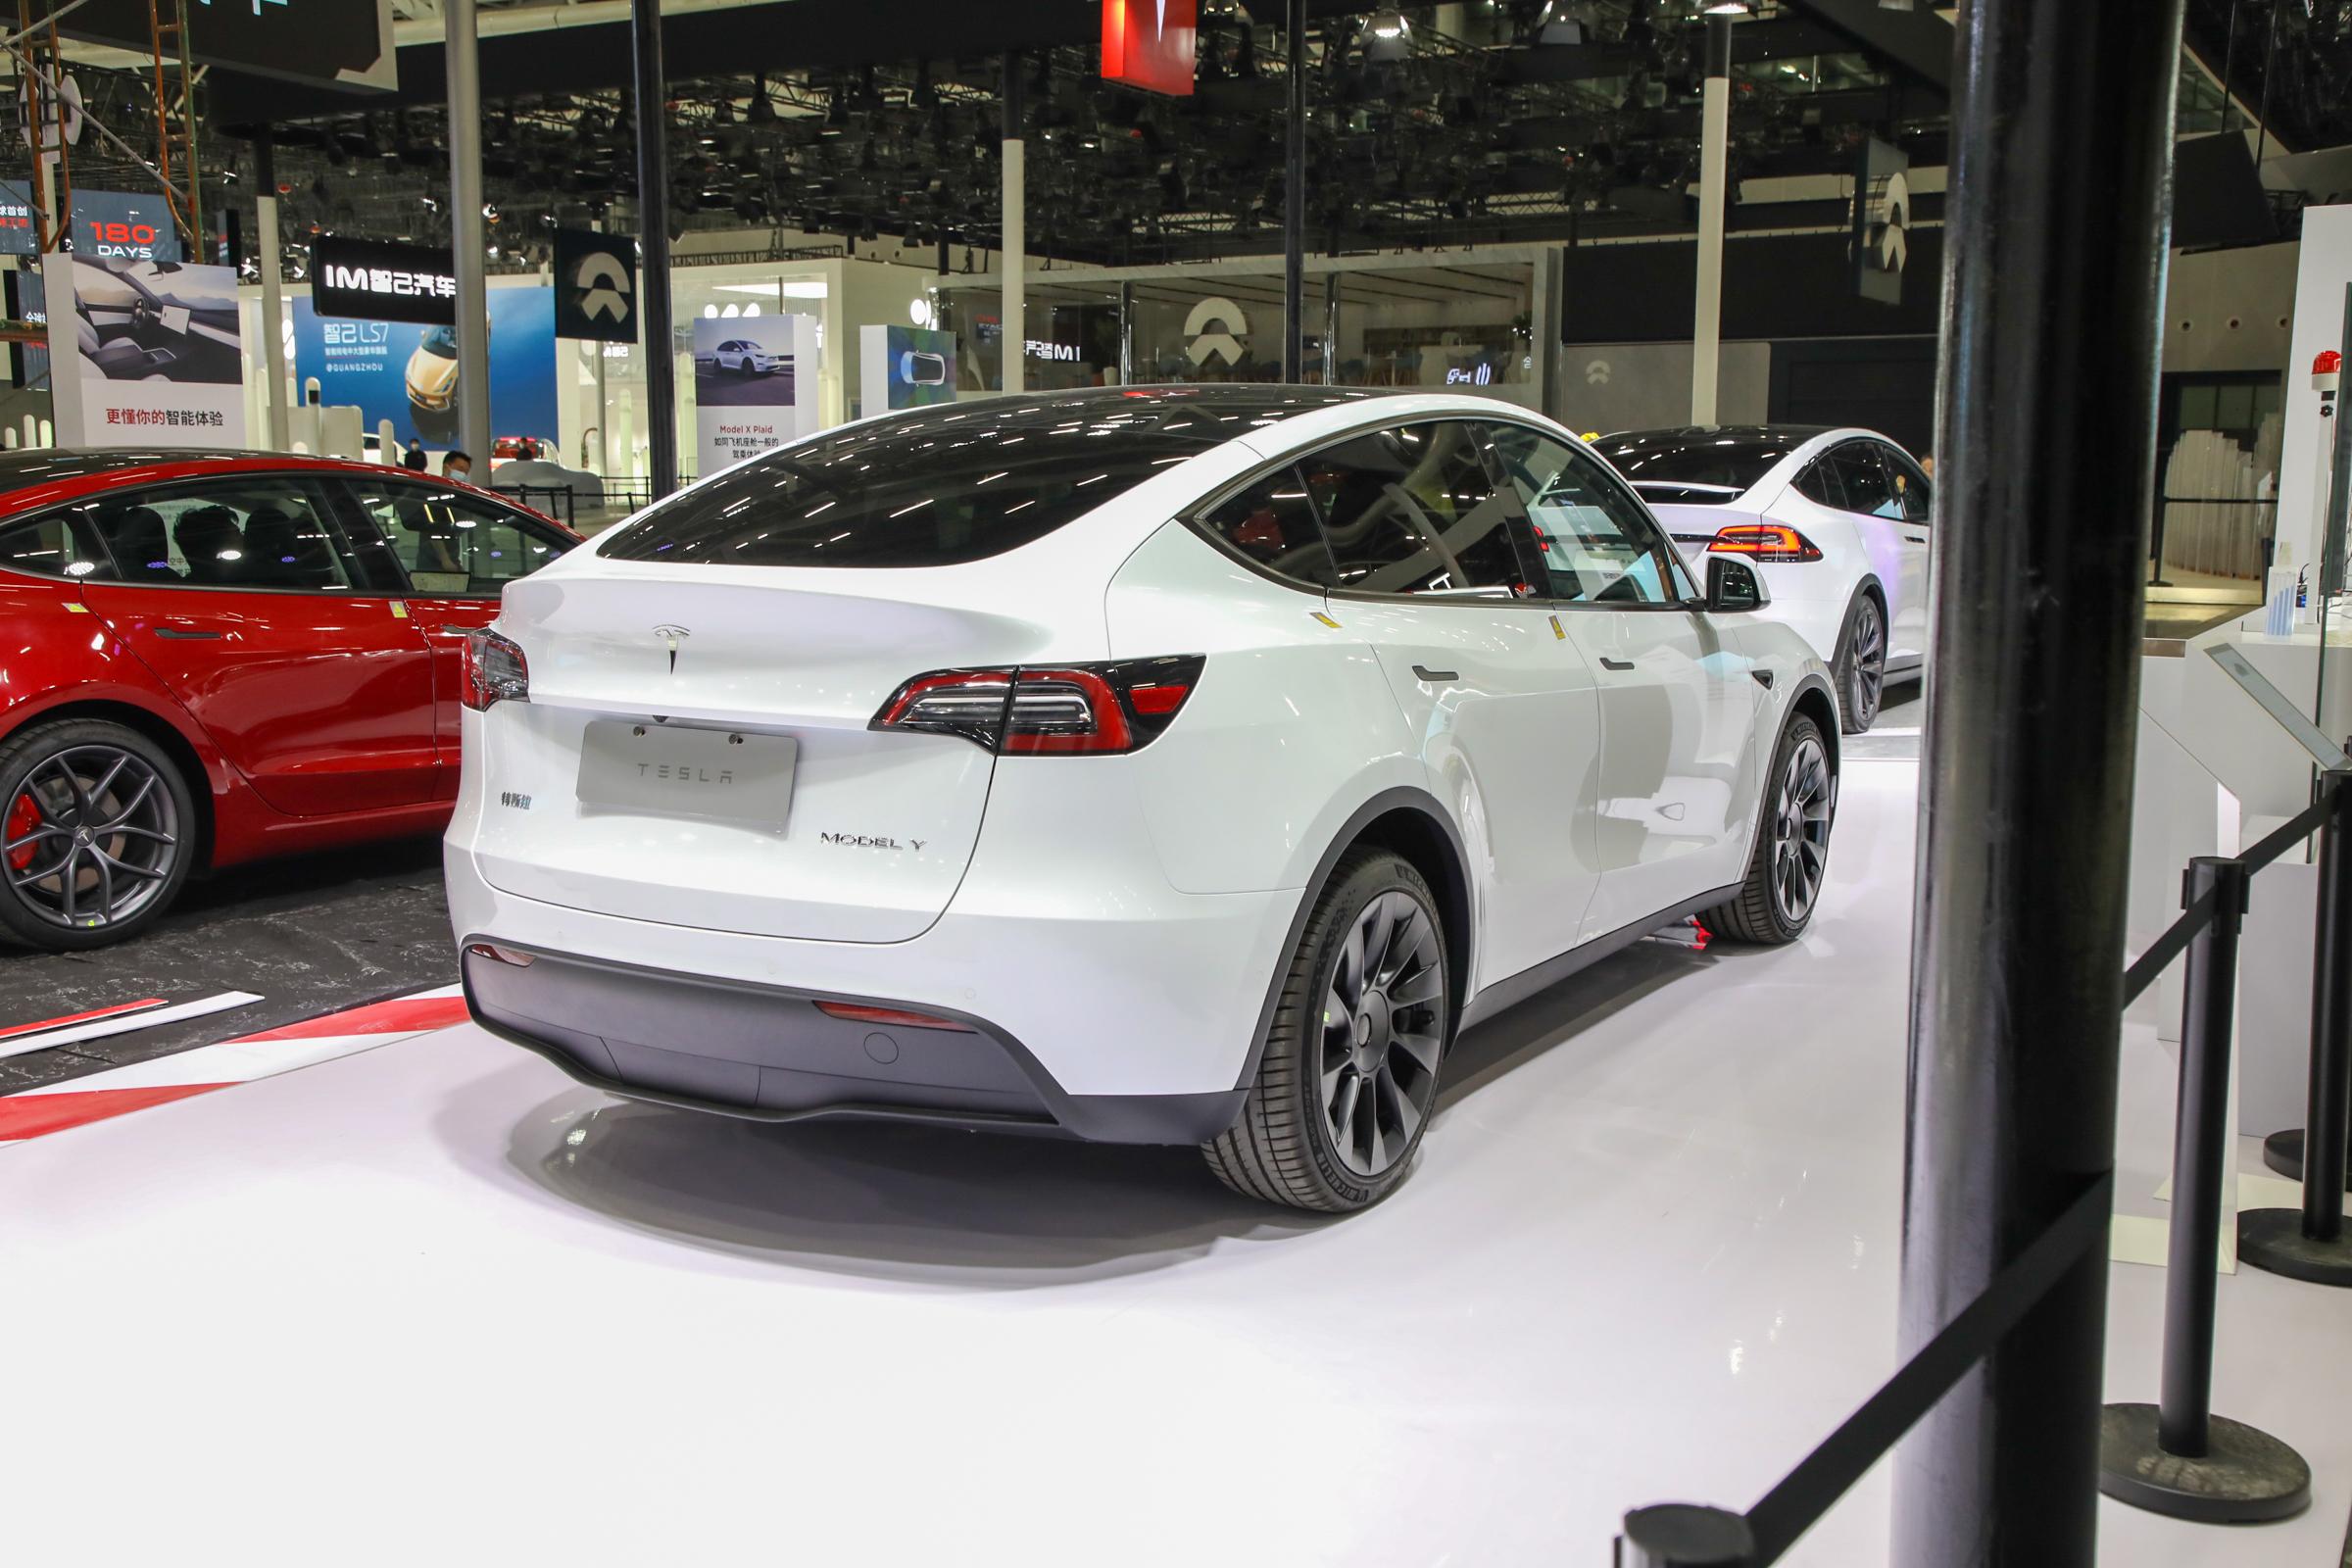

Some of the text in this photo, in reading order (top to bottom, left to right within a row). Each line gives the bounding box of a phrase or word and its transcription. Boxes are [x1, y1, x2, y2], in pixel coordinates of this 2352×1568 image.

[90, 221, 155, 243] 180
[98, 245, 153, 259] DAYS
[106, 408, 223, 426] 更懂你的智能体验
[719, 424, 773, 434] Model X Plaid
[637, 763, 733, 784] TESLA
[820, 832, 927, 852] MODEL Y
